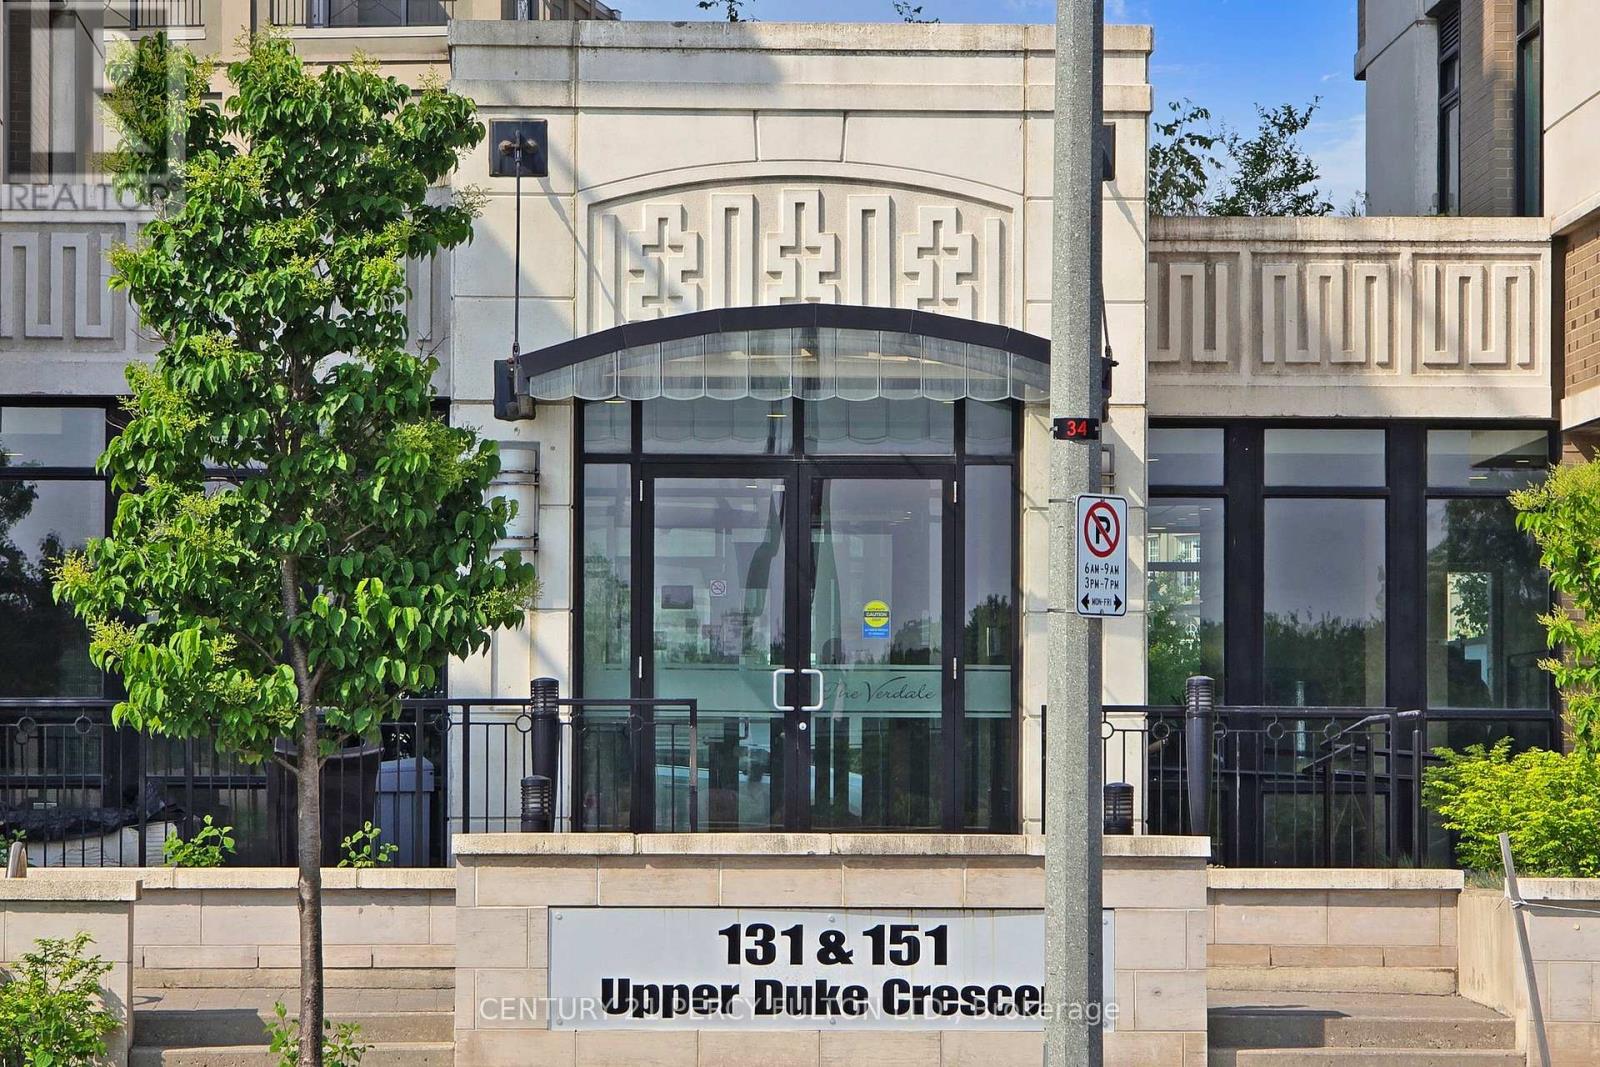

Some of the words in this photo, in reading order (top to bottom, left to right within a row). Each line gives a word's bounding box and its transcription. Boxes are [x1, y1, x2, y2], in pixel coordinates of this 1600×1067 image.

[1066, 420, 1088, 437] 34
[1091, 597, 1112, 607] MON-FRI
[864, 676, 936, 704] Verdale
[718, 923, 804, 965] 131
[817, 929, 854, 965] &
[862, 924, 948, 965] 151
[601, 978, 740, 1019] Upper
[755, 979, 869, 1016] Duke
[882, 978, 1045, 1017] Cresce
